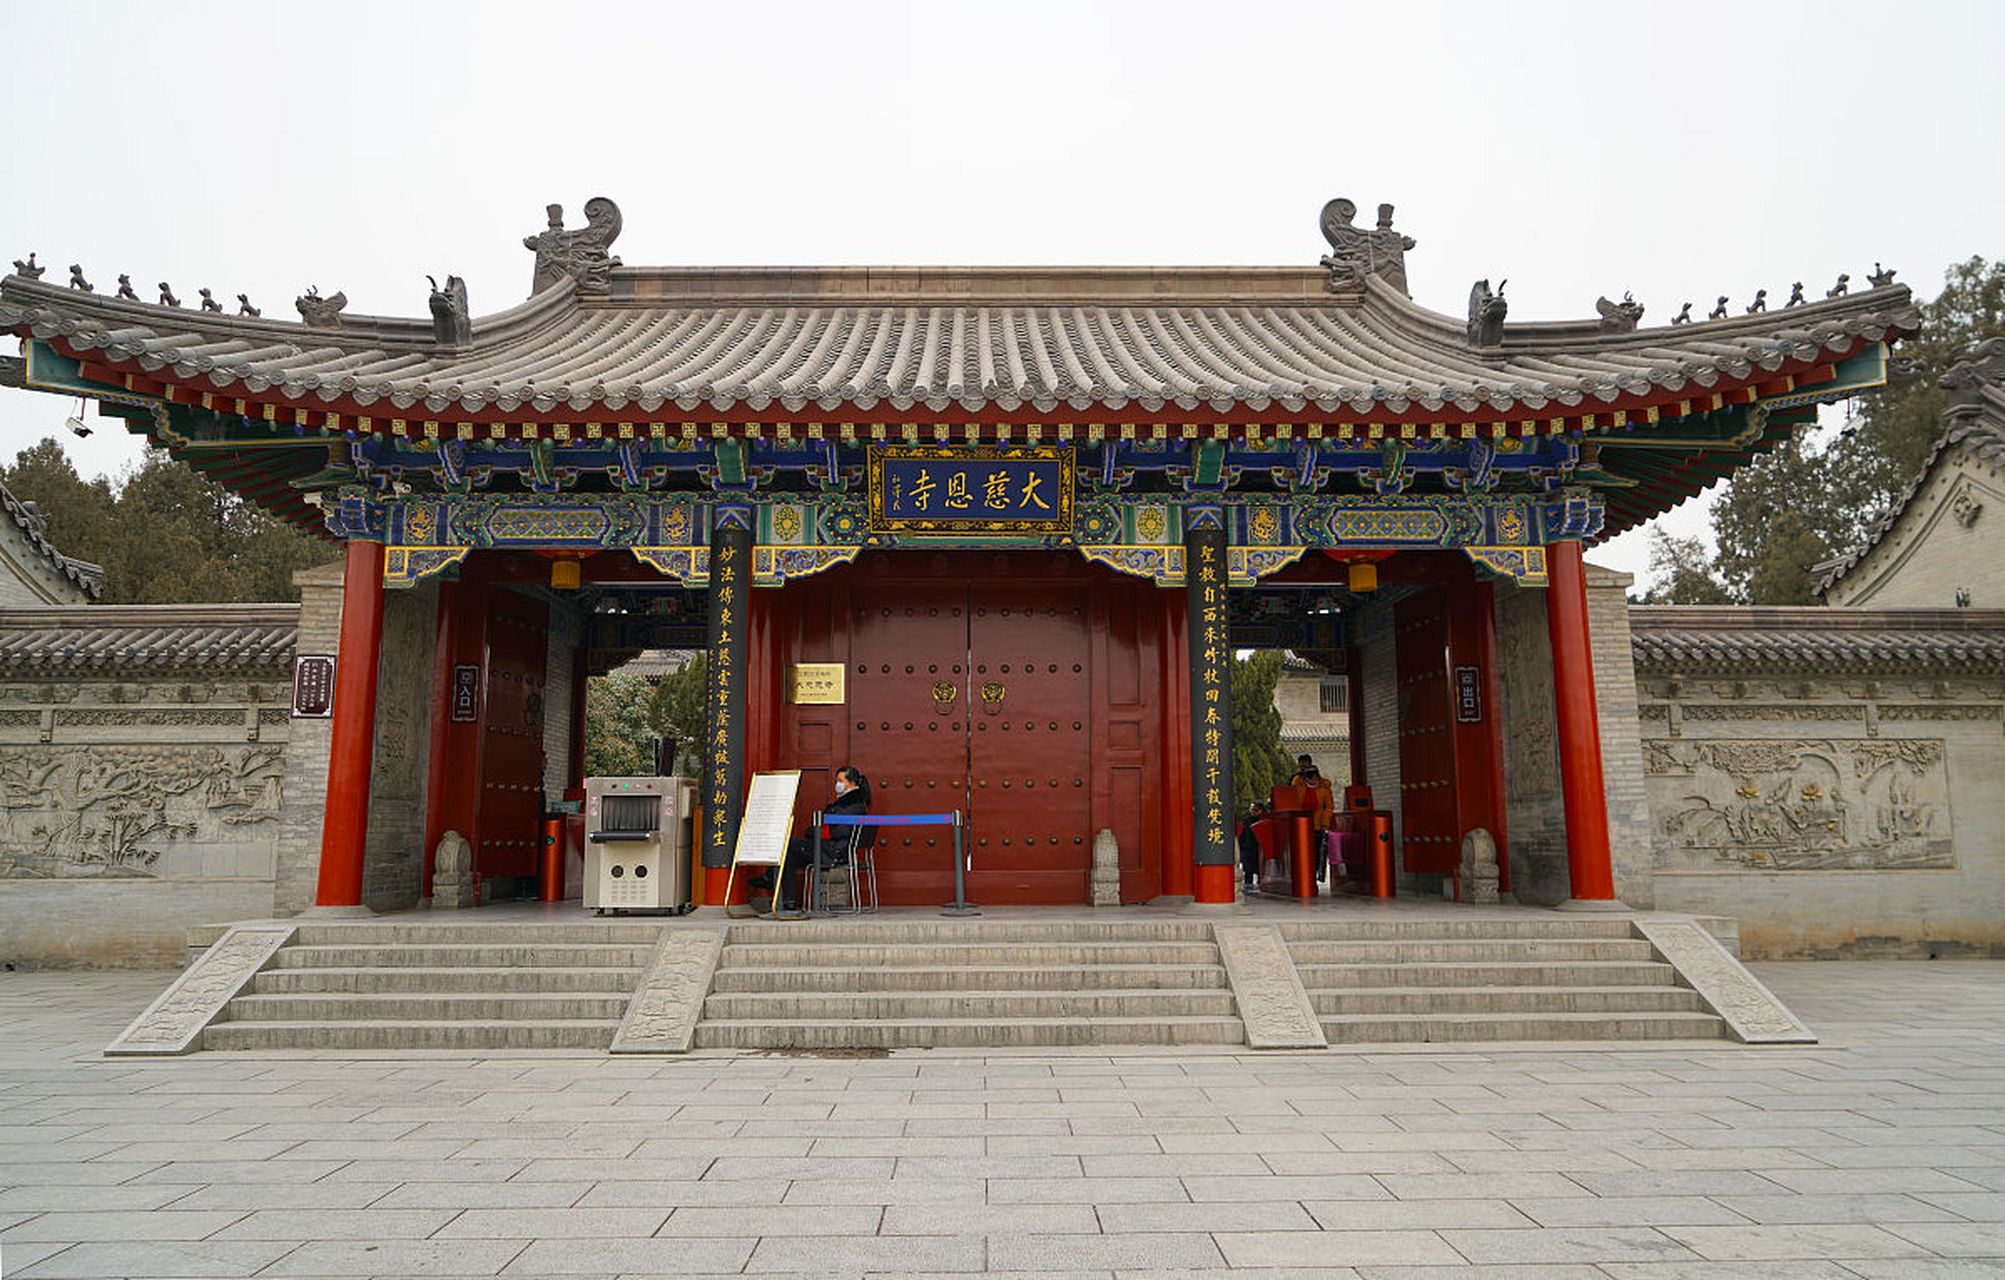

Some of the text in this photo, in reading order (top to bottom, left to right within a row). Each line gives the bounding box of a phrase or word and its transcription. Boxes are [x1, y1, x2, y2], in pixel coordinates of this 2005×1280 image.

[908, 469, 1050, 511] 大慈恩寺
[460, 686, 471, 707] 入口
[1463, 686, 1475, 708] 出口
